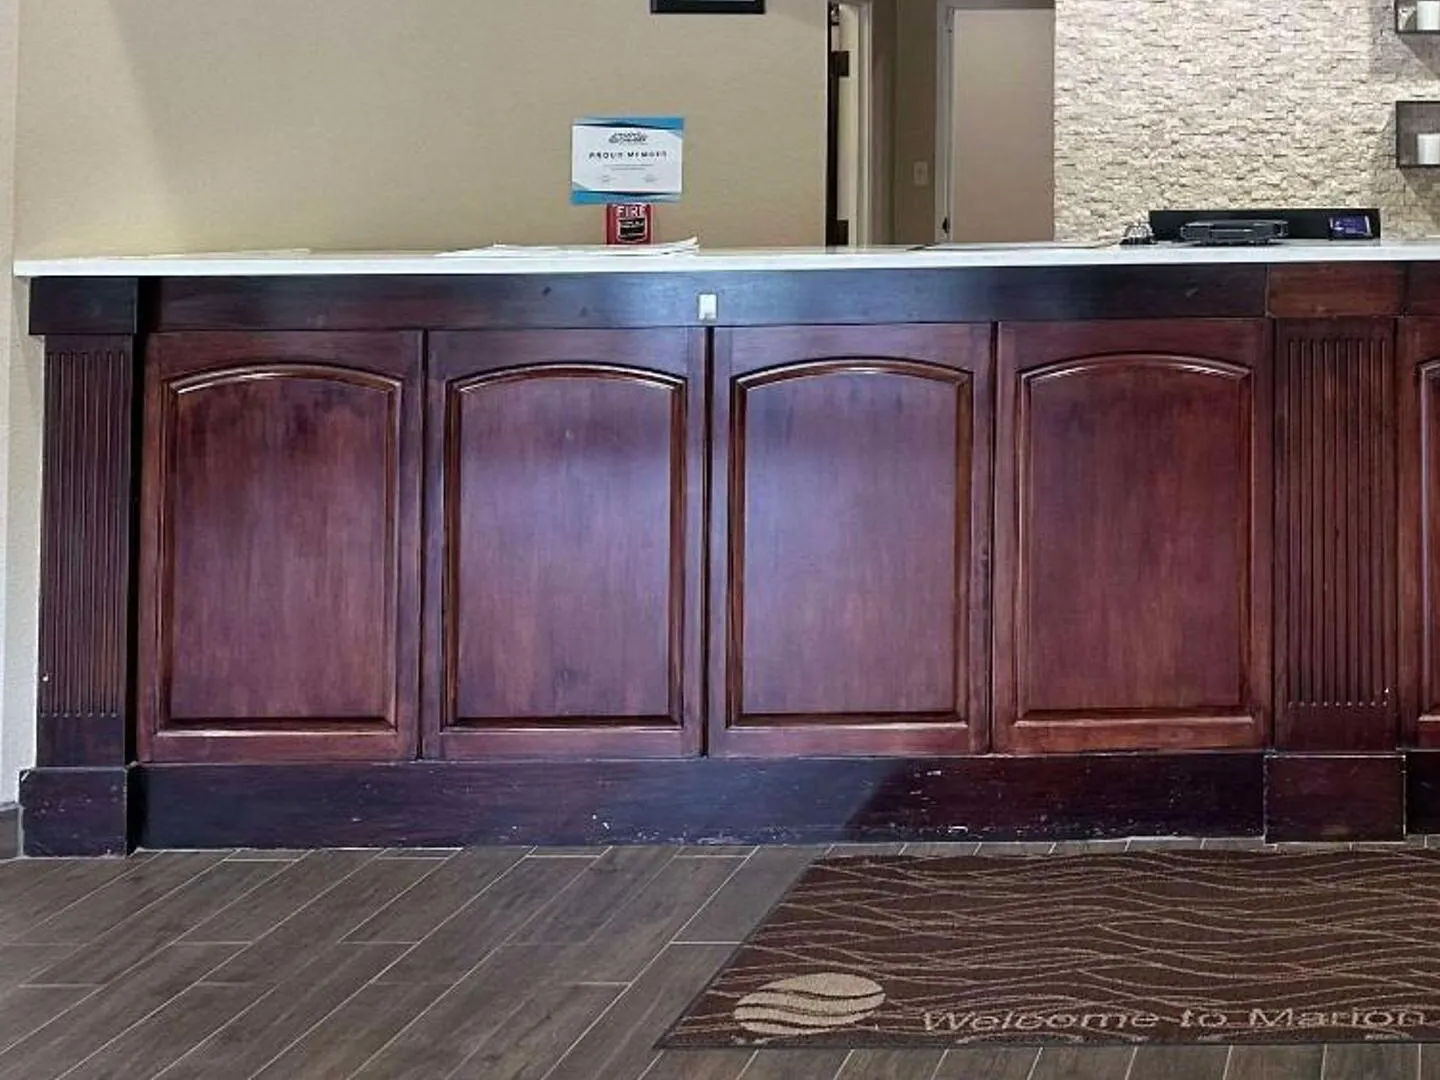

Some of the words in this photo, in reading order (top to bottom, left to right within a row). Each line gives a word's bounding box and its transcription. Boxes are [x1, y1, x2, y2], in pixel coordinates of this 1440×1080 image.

[616, 205, 645, 217] FIRE
[923, 1012, 1159, 1030] Welcome
[1180, 1009, 1228, 1028] to
